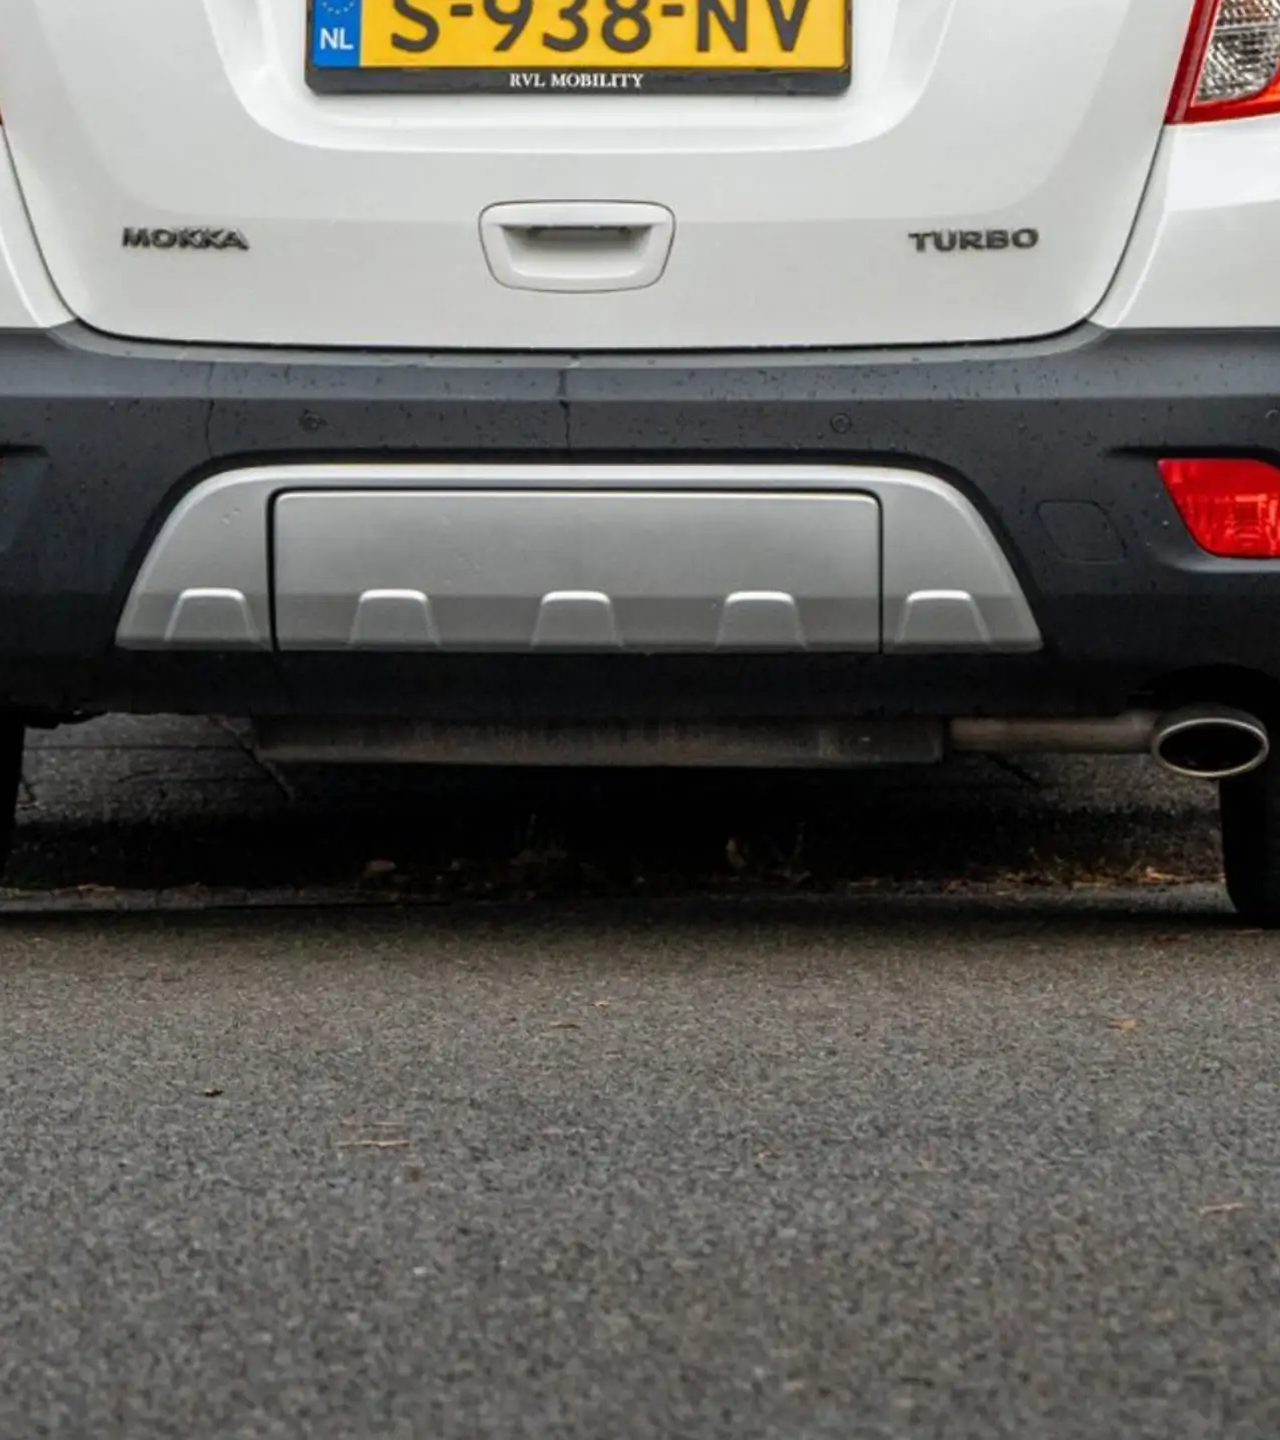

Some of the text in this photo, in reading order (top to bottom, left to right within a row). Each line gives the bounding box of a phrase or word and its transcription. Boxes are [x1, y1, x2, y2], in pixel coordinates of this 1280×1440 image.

[320, 27, 354, 51] NL
[509, 72, 644, 89] RVL MOBILITY
[122, 226, 250, 251] MOKKA
[908, 227, 1040, 253] TURBO
